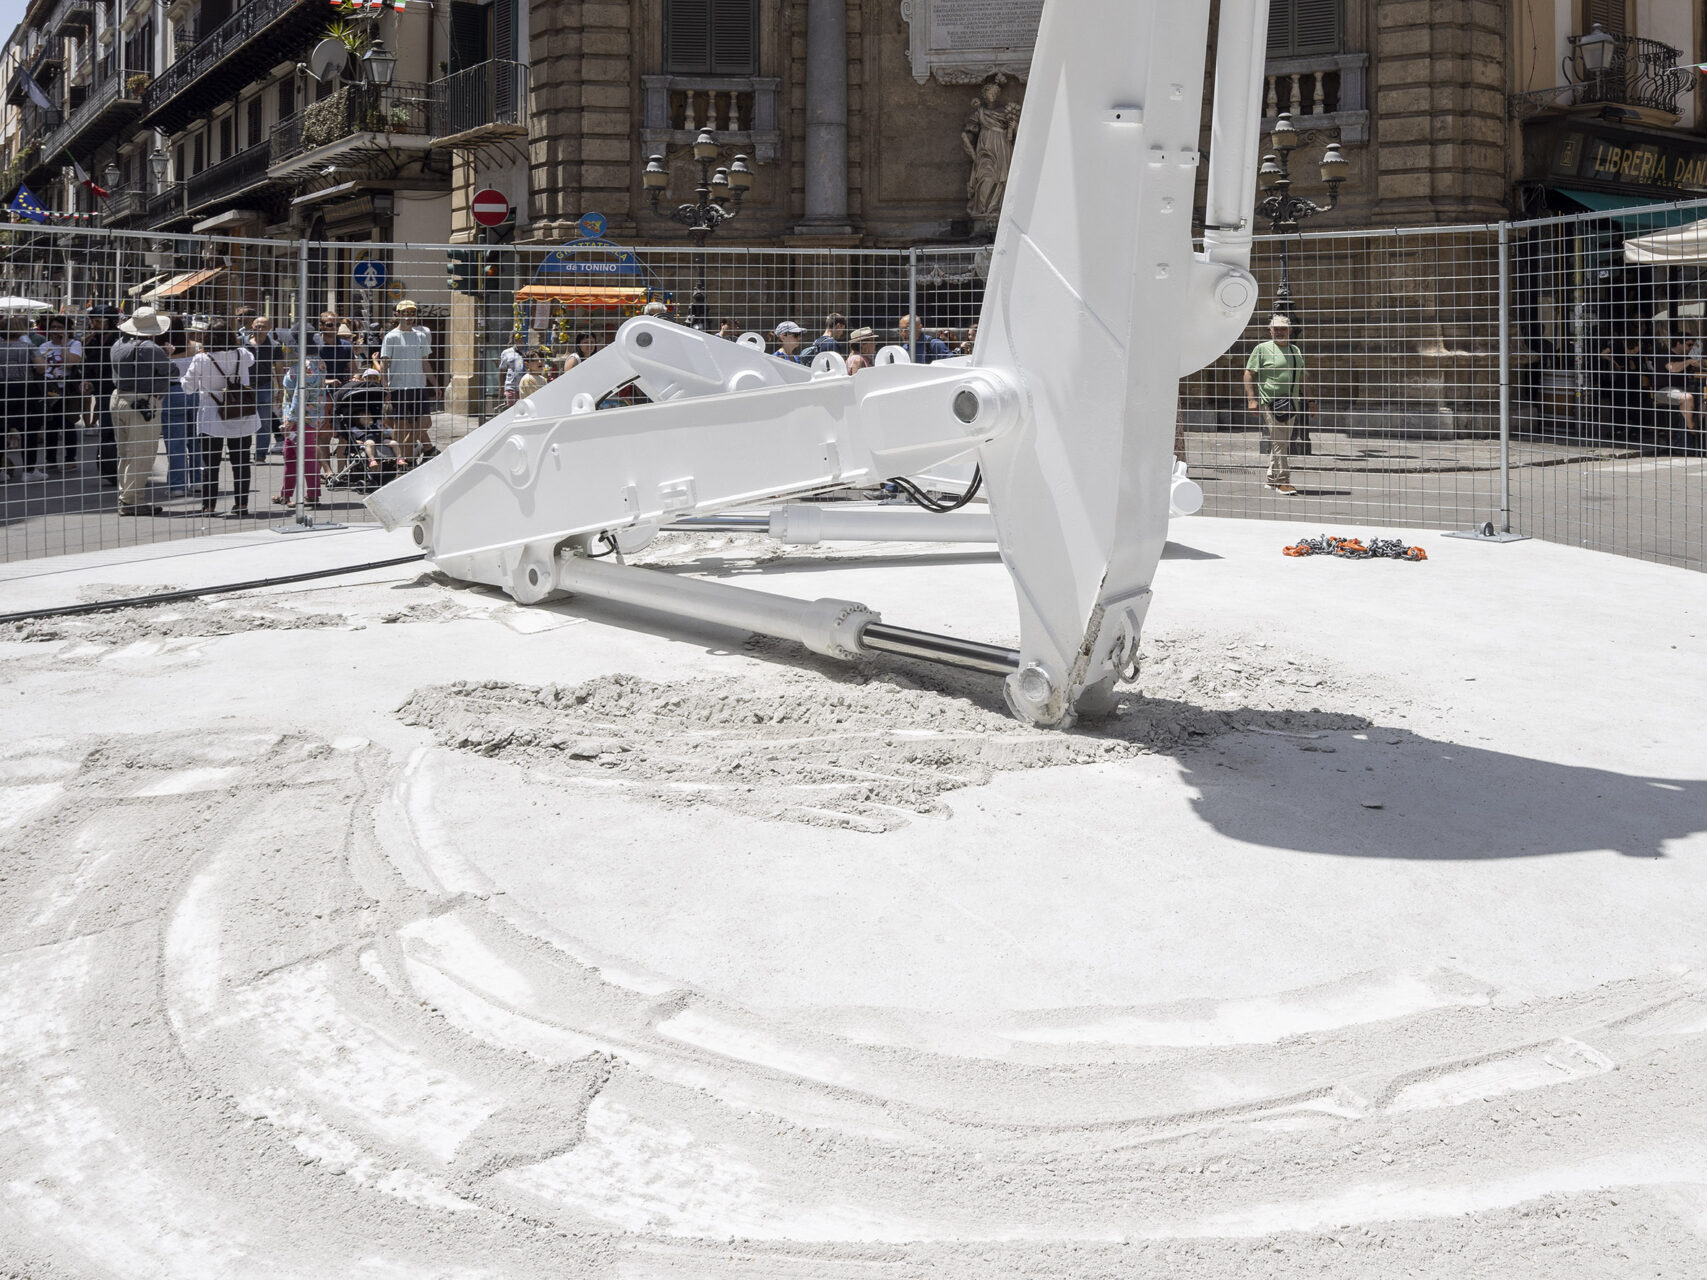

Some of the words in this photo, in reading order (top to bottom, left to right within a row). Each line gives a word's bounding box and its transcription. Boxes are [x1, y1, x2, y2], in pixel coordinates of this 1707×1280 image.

[1595, 145, 1666, 178] LIBRERIA
[1674, 157, 1707, 185] DAN
[566, 263, 577, 271] da
[581, 263, 617, 272] TONINO
